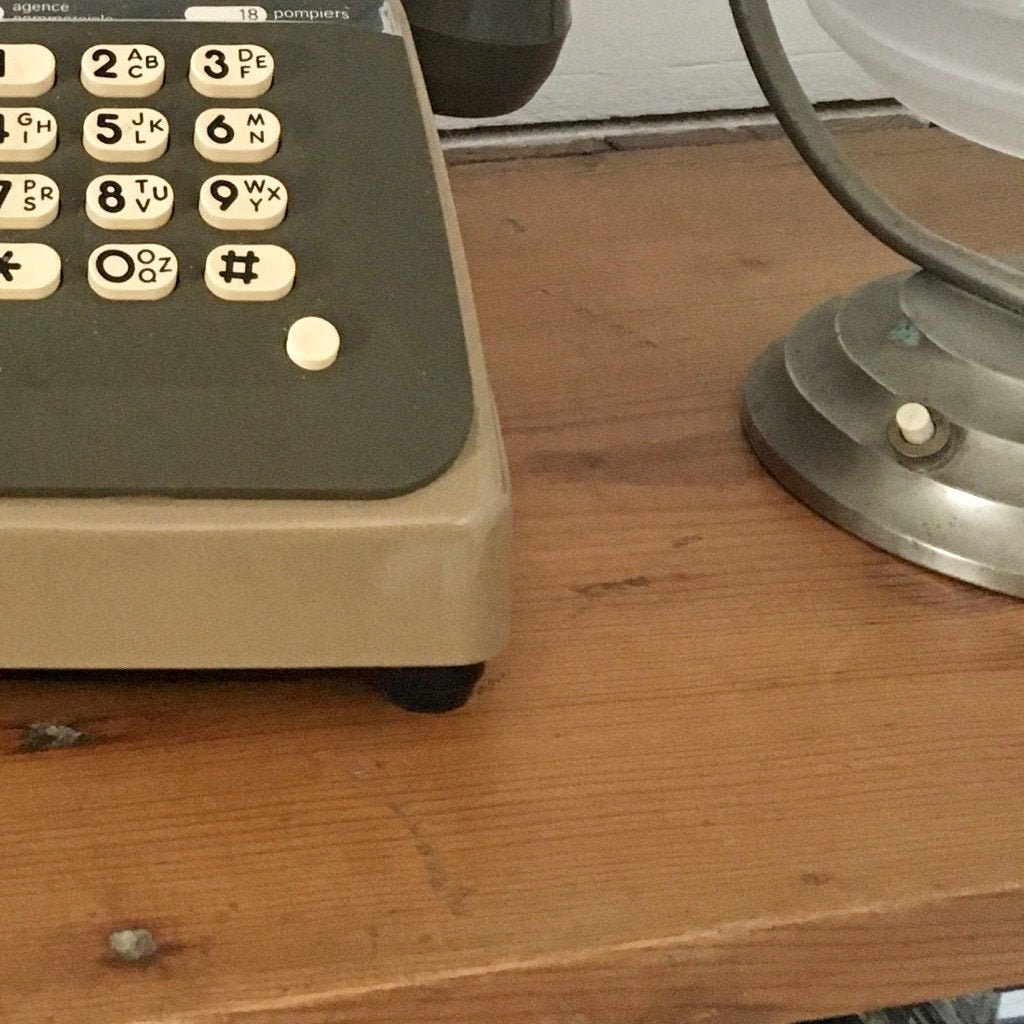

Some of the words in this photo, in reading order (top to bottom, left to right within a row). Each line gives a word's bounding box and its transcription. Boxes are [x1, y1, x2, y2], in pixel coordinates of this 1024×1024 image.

[11, 2, 70, 14] agence
[238, 8, 259, 21] 18
[273, 7, 350, 21] pompiers
[91, 49, 118, 78] 2
[203, 49, 229, 79] 3
[96, 114, 122, 144] 5
[206, 114, 235, 144] 6
[98, 180, 126, 213] 8
[209, 180, 238, 211] 9
